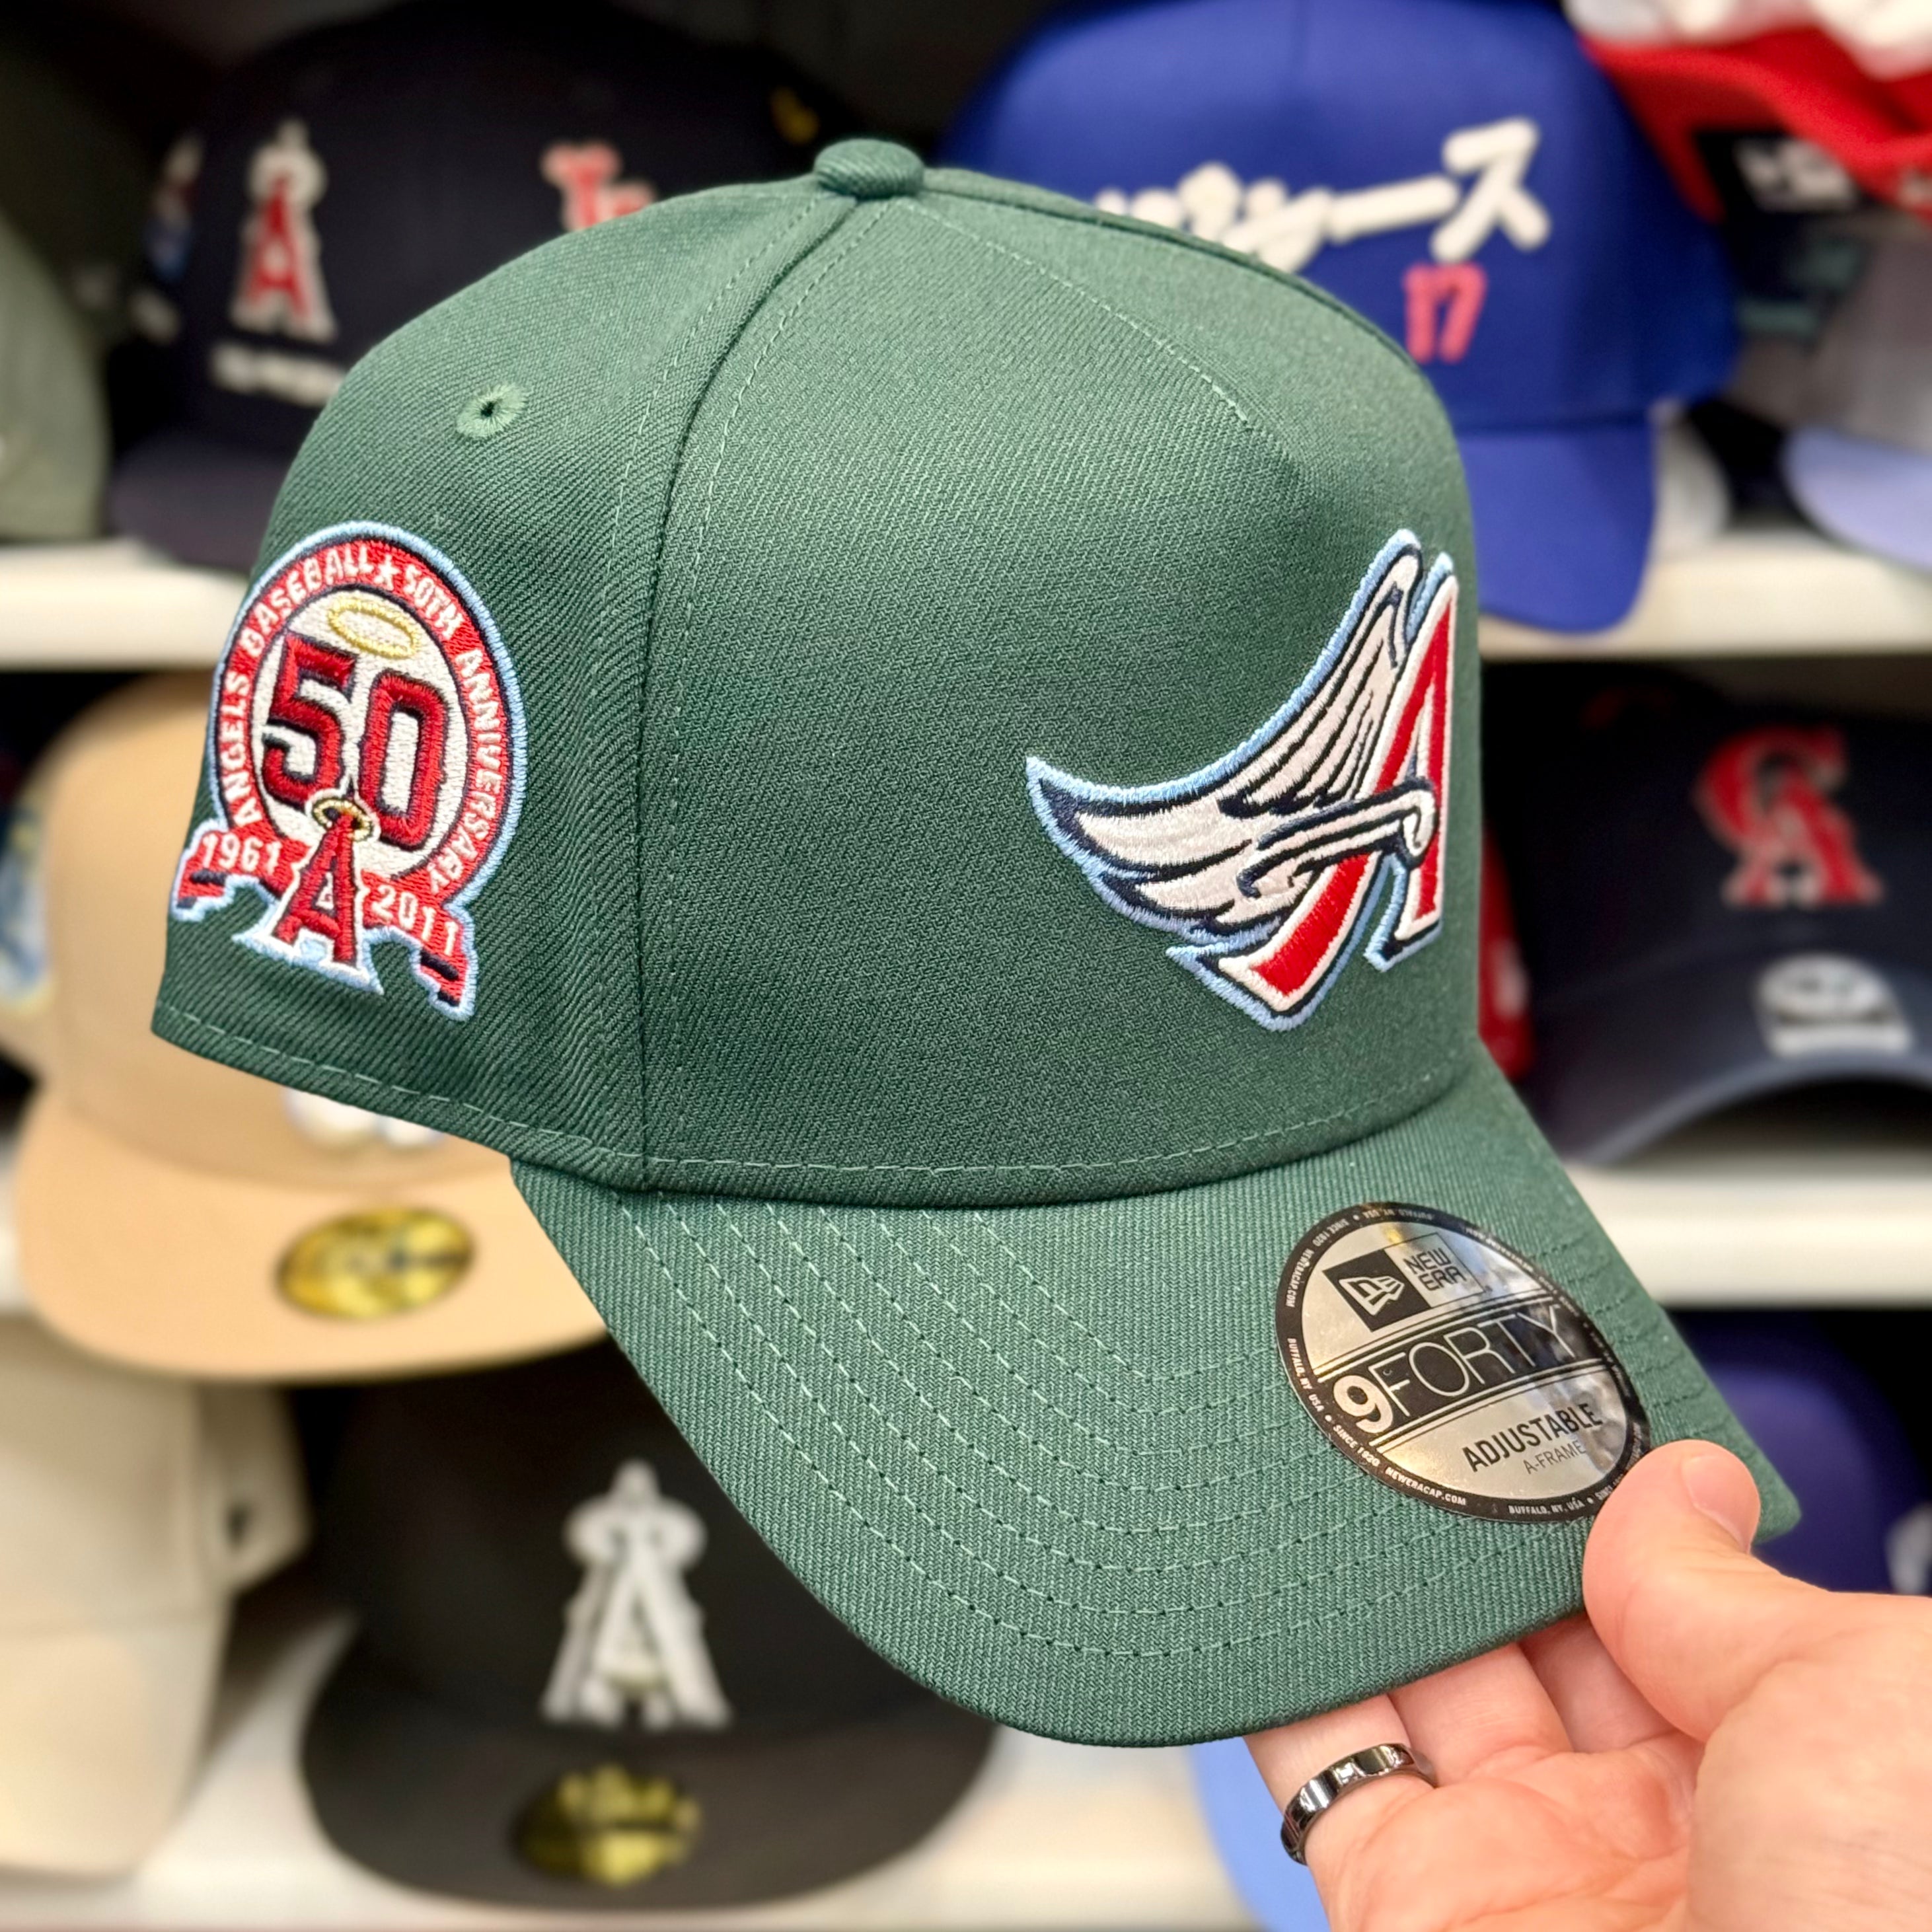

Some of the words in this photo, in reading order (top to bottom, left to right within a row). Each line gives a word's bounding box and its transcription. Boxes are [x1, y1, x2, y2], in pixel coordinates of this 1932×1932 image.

[220, 670, 262, 826] ANGELS
[241, 545, 375, 658] BASEBALL
[426, 649, 503, 894] ANNIVERSARY
[262, 628, 449, 853] 50
[202, 832, 283, 875] 1961
[260, 809, 361, 970] A
[371, 884, 459, 957] 2011
[1327, 1218, 1349, 1234] SINCE
[1403, 1247, 1452, 1275] NEW
[1418, 1266, 1468, 1291] ERA
[1333, 1304, 1577, 1434] 9FORTY
[1308, 1393, 1324, 1413] USA
[1333, 1425, 1357, 1449] SINCE
[1356, 1447, 1381, 1467] 1920
[1385, 1466, 1467, 1506] NEWERACAP.COM
[1462, 1403, 1604, 1473] ADJUSTABLE
[1523, 1440, 1586, 1475] A-FRAME
